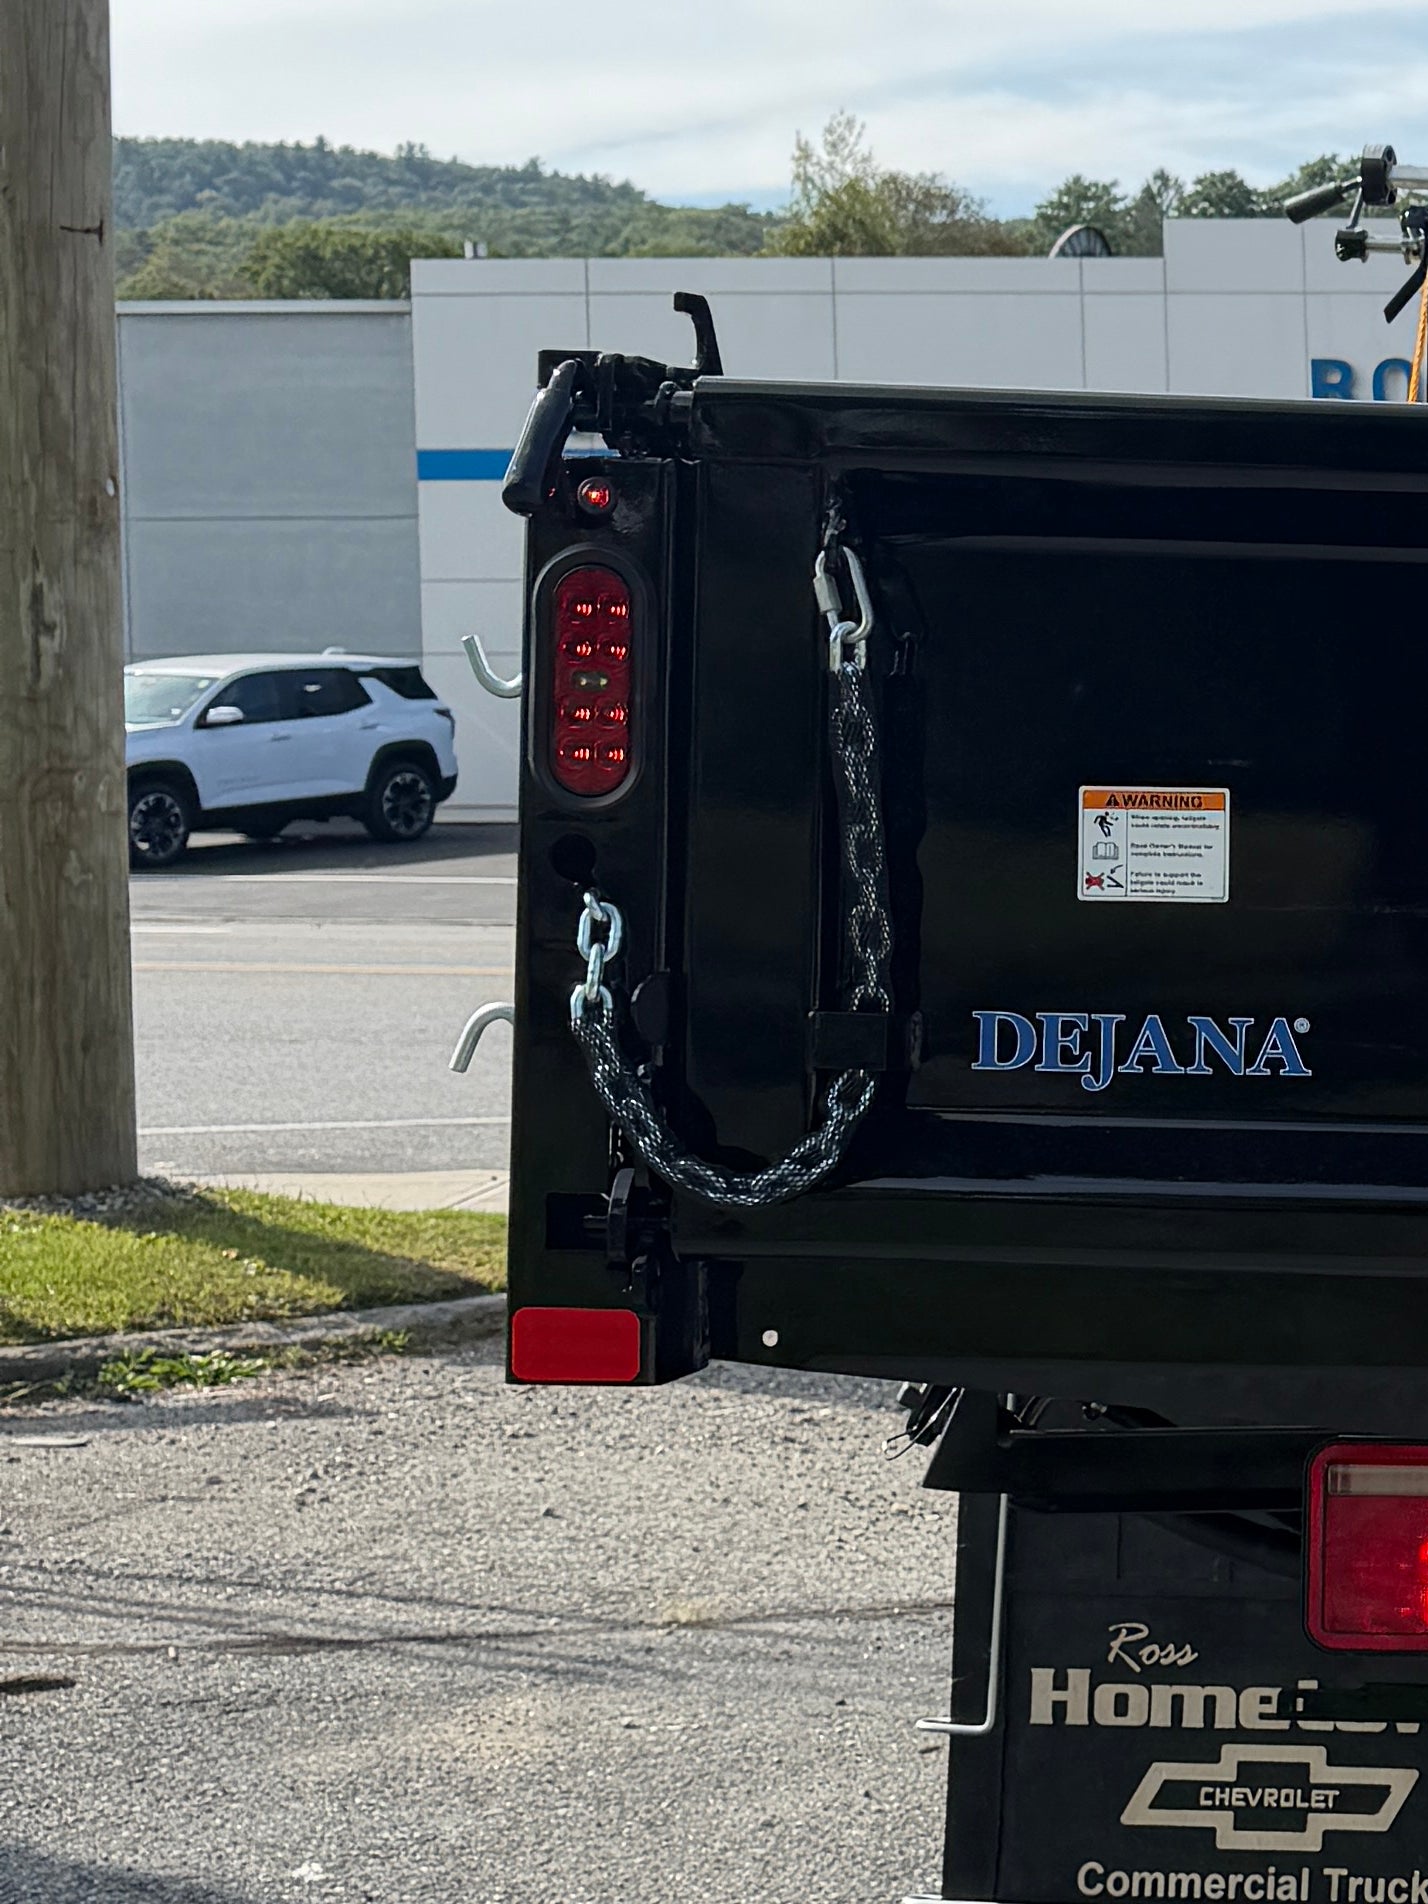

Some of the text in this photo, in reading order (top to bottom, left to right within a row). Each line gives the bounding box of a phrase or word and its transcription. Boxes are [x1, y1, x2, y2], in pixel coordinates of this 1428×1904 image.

[1122, 794, 1203, 808] WARNING
[1107, 1622, 1198, 1673] Ross
[1199, 1786, 1340, 1809] CHEVROLET
[1077, 1861, 1310, 1902] Commercial
